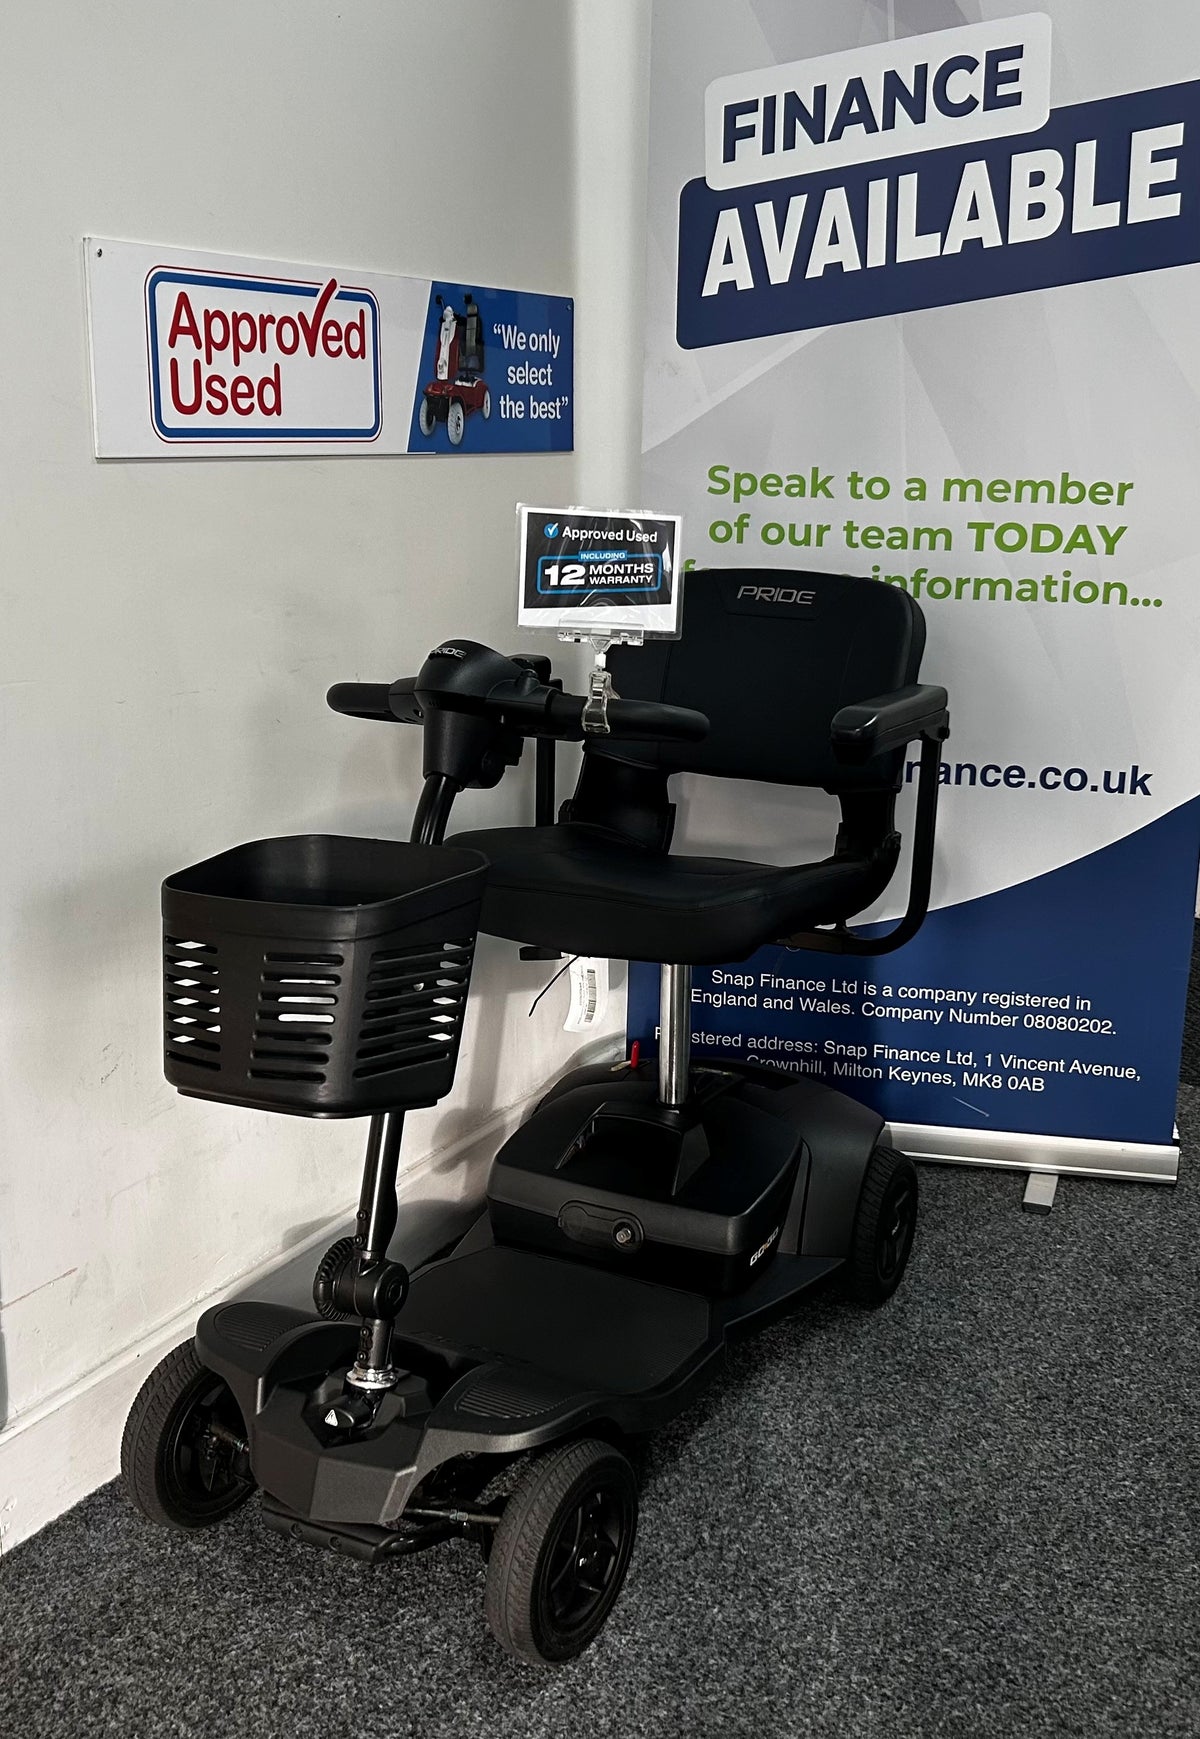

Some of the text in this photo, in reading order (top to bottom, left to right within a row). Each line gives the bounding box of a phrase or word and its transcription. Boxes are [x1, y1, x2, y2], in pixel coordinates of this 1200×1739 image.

[722, 44, 1025, 164] FINANCE
[701, 122, 1185, 298] AVAILABLE
[168, 278, 367, 367] Approved
[493, 323, 561, 359] “We only
[169, 358, 282, 417] Used
[507, 362, 553, 386] select
[500, 395, 569, 421] the best”
[706, 464, 1134, 506] Speak to a member
[562, 526, 658, 543] Approved Used
[708, 514, 1128, 556] of our team TODAY
[580, 552, 626, 560] INCLUDING
[589, 563, 654, 576] MONTHS
[544, 564, 586, 586] 12
[589, 574, 653, 585] WARRANTY
[736, 585, 817, 605] PRIDE
[905, 760, 1154, 796] nance.co.uk
[711, 969, 1092, 1011] Snap Finance Ltd is a company registered in
[691, 988, 1118, 1035] England and Wales. Company Number 08080202.
[654, 1026, 1142, 1082] stered address: Snap Finance Ltd, 1 Vincent Avenue,
[833, 1060, 884, 1080] Milton
[888, 1066, 957, 1088] Keynes,
[962, 1072, 1003, 1090] MK8
[1007, 1076, 1046, 1093] 0AB
